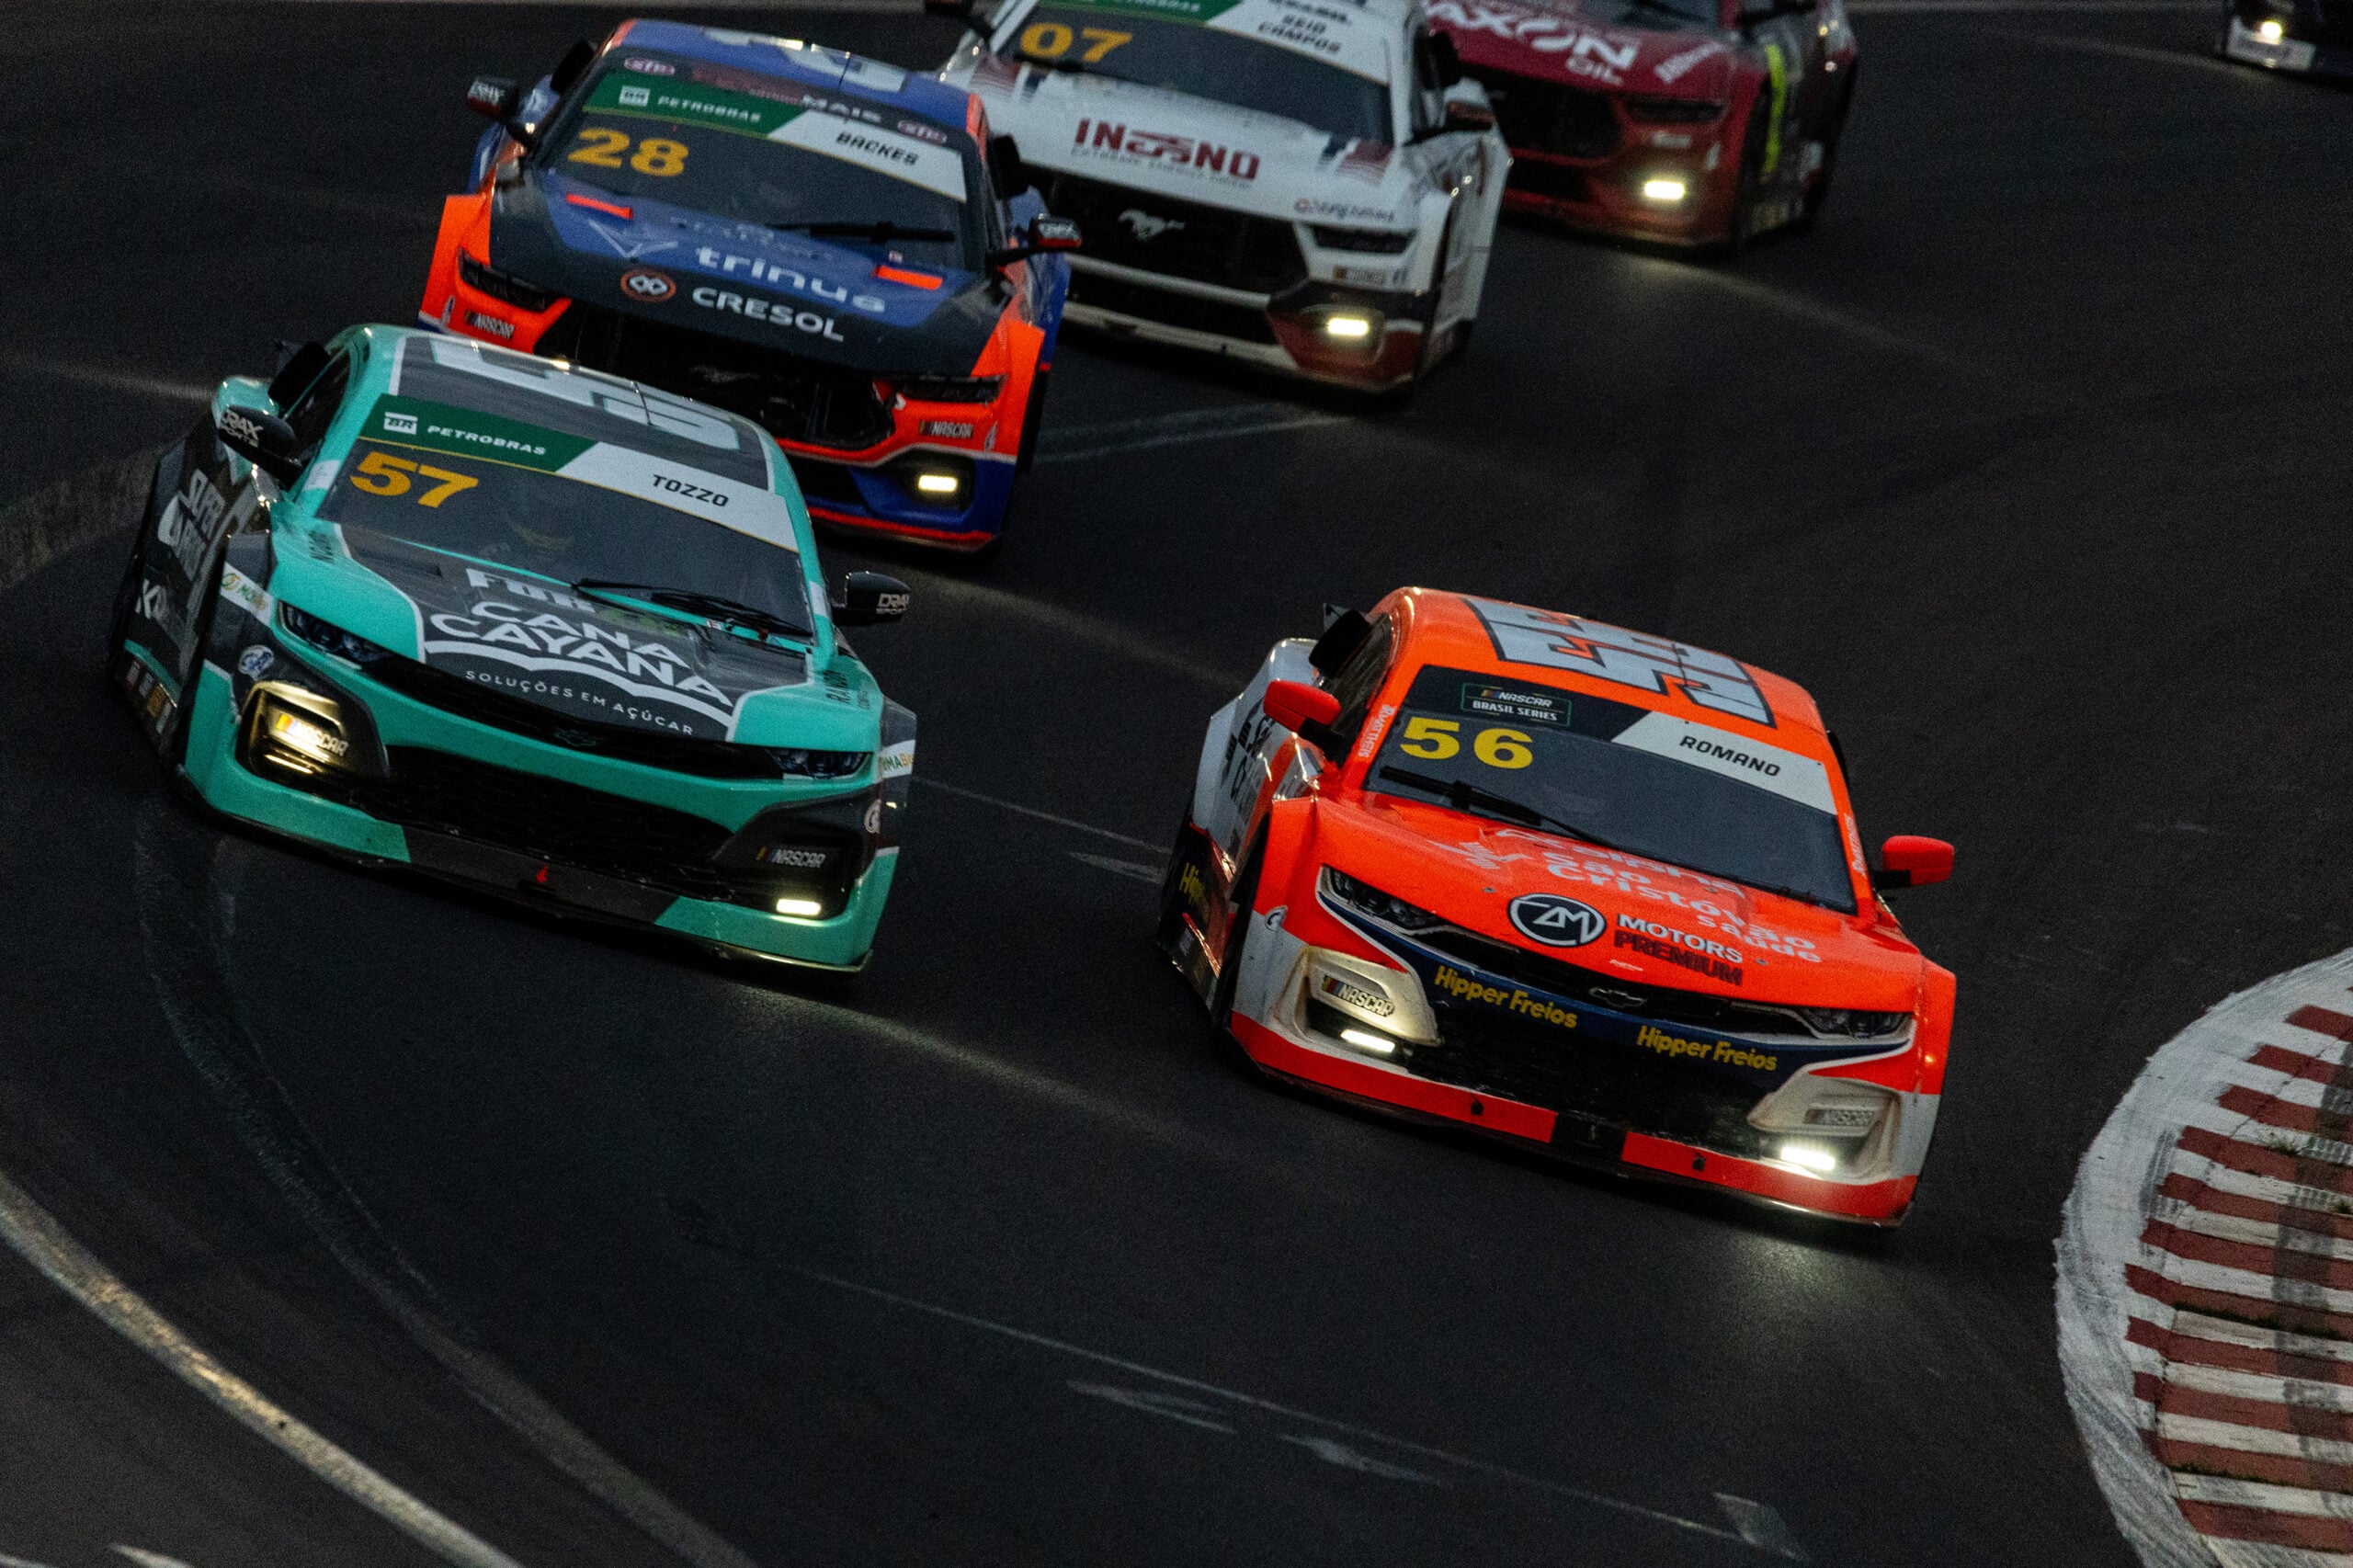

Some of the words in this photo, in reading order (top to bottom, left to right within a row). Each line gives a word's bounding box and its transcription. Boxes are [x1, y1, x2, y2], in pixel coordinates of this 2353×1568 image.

[1020, 22, 1132, 62] 07
[658, 96, 761, 123] PETROBRAS
[568, 128, 688, 176] 28
[837, 131, 918, 165] BACKES
[692, 287, 844, 343] CRESOL
[427, 425, 547, 456] PETROBRAS
[931, 420, 973, 438] NASCAR
[349, 451, 479, 508] 57
[653, 474, 729, 506] TOZZO
[472, 601, 691, 669] CANA
[429, 614, 734, 707] CAYANA
[465, 670, 573, 699] SOLUÇÕES
[580, 692, 607, 707] EM
[612, 701, 693, 735] AÇÚCAR
[1472, 700, 1514, 714] BRASIL
[1517, 707, 1557, 722] SERIES
[1498, 691, 1552, 708] NASCAR
[1400, 716, 1533, 769] 56
[1679, 735, 1780, 777] ROMANO
[772, 848, 826, 868] NASCAR
[1615, 930, 1744, 986] PREMIUM
[1618, 914, 1744, 963] MOTORS
[1337, 983, 1395, 1017] NASCAR
[1434, 965, 1509, 1006] Hipper
[1508, 989, 1578, 1029] Freios
[1636, 1025, 1712, 1059] Hipper
[1712, 1040, 1778, 1072] Freios
